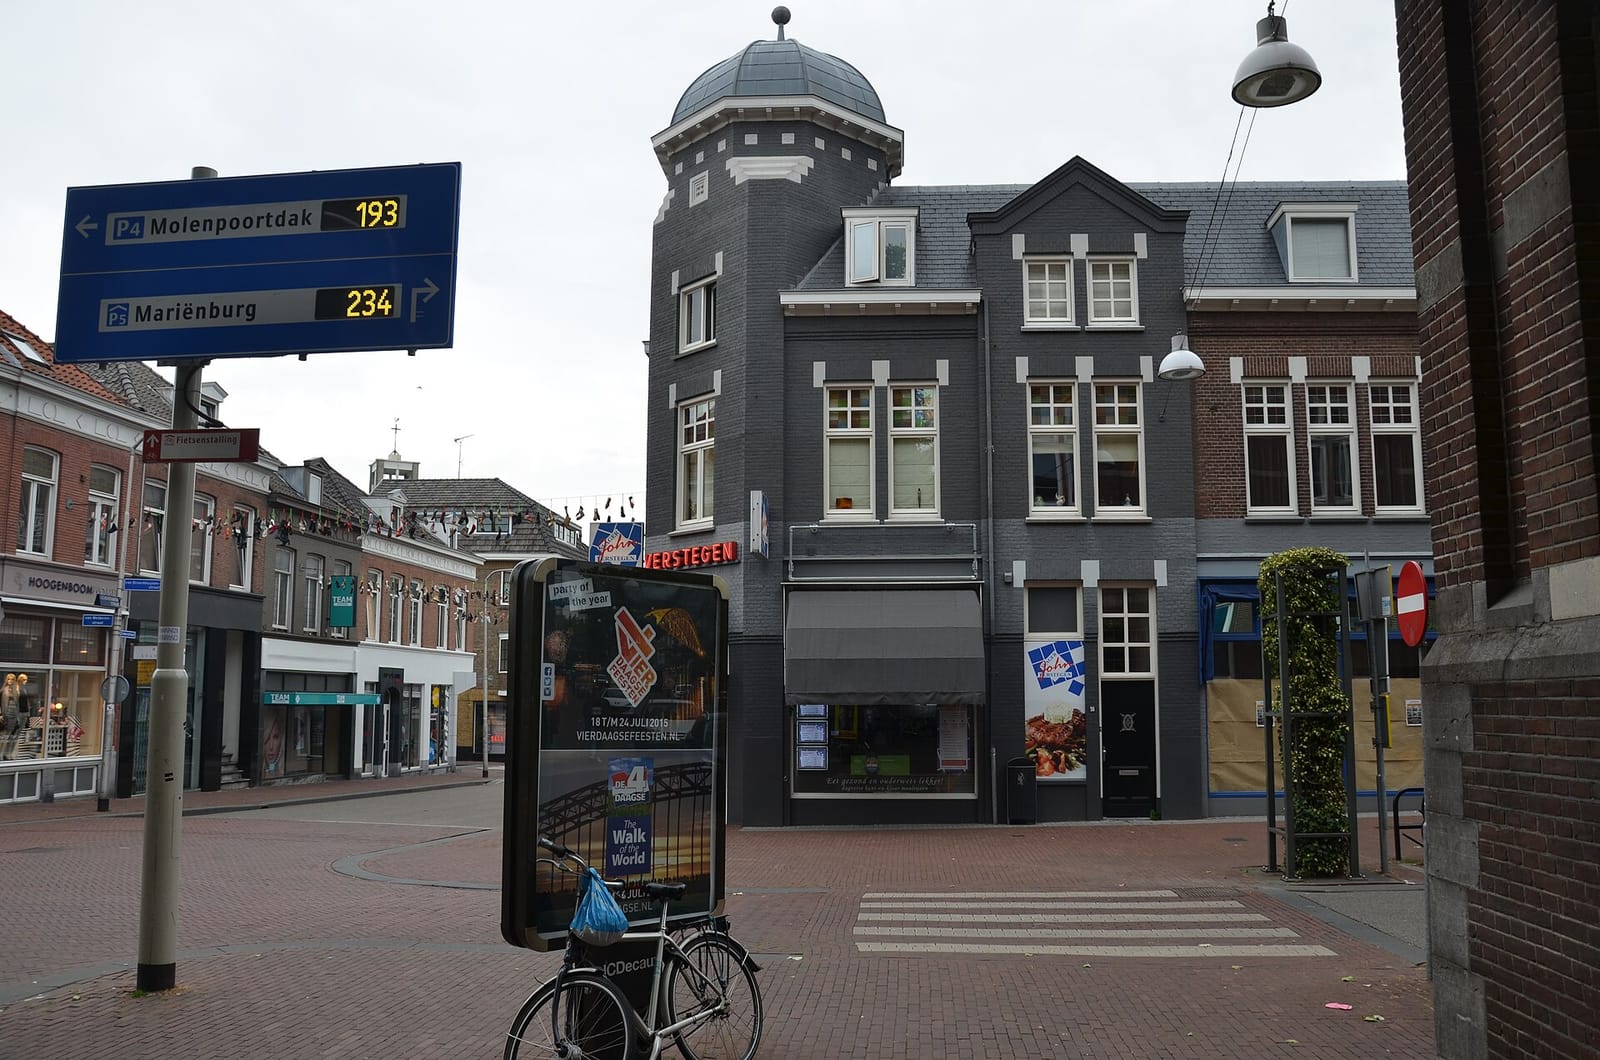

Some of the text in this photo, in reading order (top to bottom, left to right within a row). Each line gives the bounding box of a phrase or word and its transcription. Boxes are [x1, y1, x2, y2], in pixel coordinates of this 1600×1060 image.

[356, 200, 398, 228] 193
[116, 209, 313, 237] P4 Molenpoortdak
[346, 288, 392, 317] 234
[135, 302, 257, 323] Mariënburg
[176, 435, 238, 445] Fietsenstalling
[645, 541, 737, 570] VERSTEGEN
[28, 577, 93, 594] HOOGENBOOM
[553, 581, 589, 596] party of
[572, 594, 609, 607] the year
[609, 664, 641, 705] FEESTEN
[615, 657, 648, 698] DAAGSE
[591, 717, 600, 727] 18
[619, 717, 629, 727] 24
[630, 718, 648, 727] JULI
[576, 730, 680, 741] VIERDAAGSEFEESTEN.NL
[615, 780, 626, 789] DE
[614, 793, 646, 802] DAAGSE
[624, 819, 637, 829] The
[612, 828, 646, 844] Walk
[619, 843, 640, 854] of the
[612, 852, 645, 866] World
